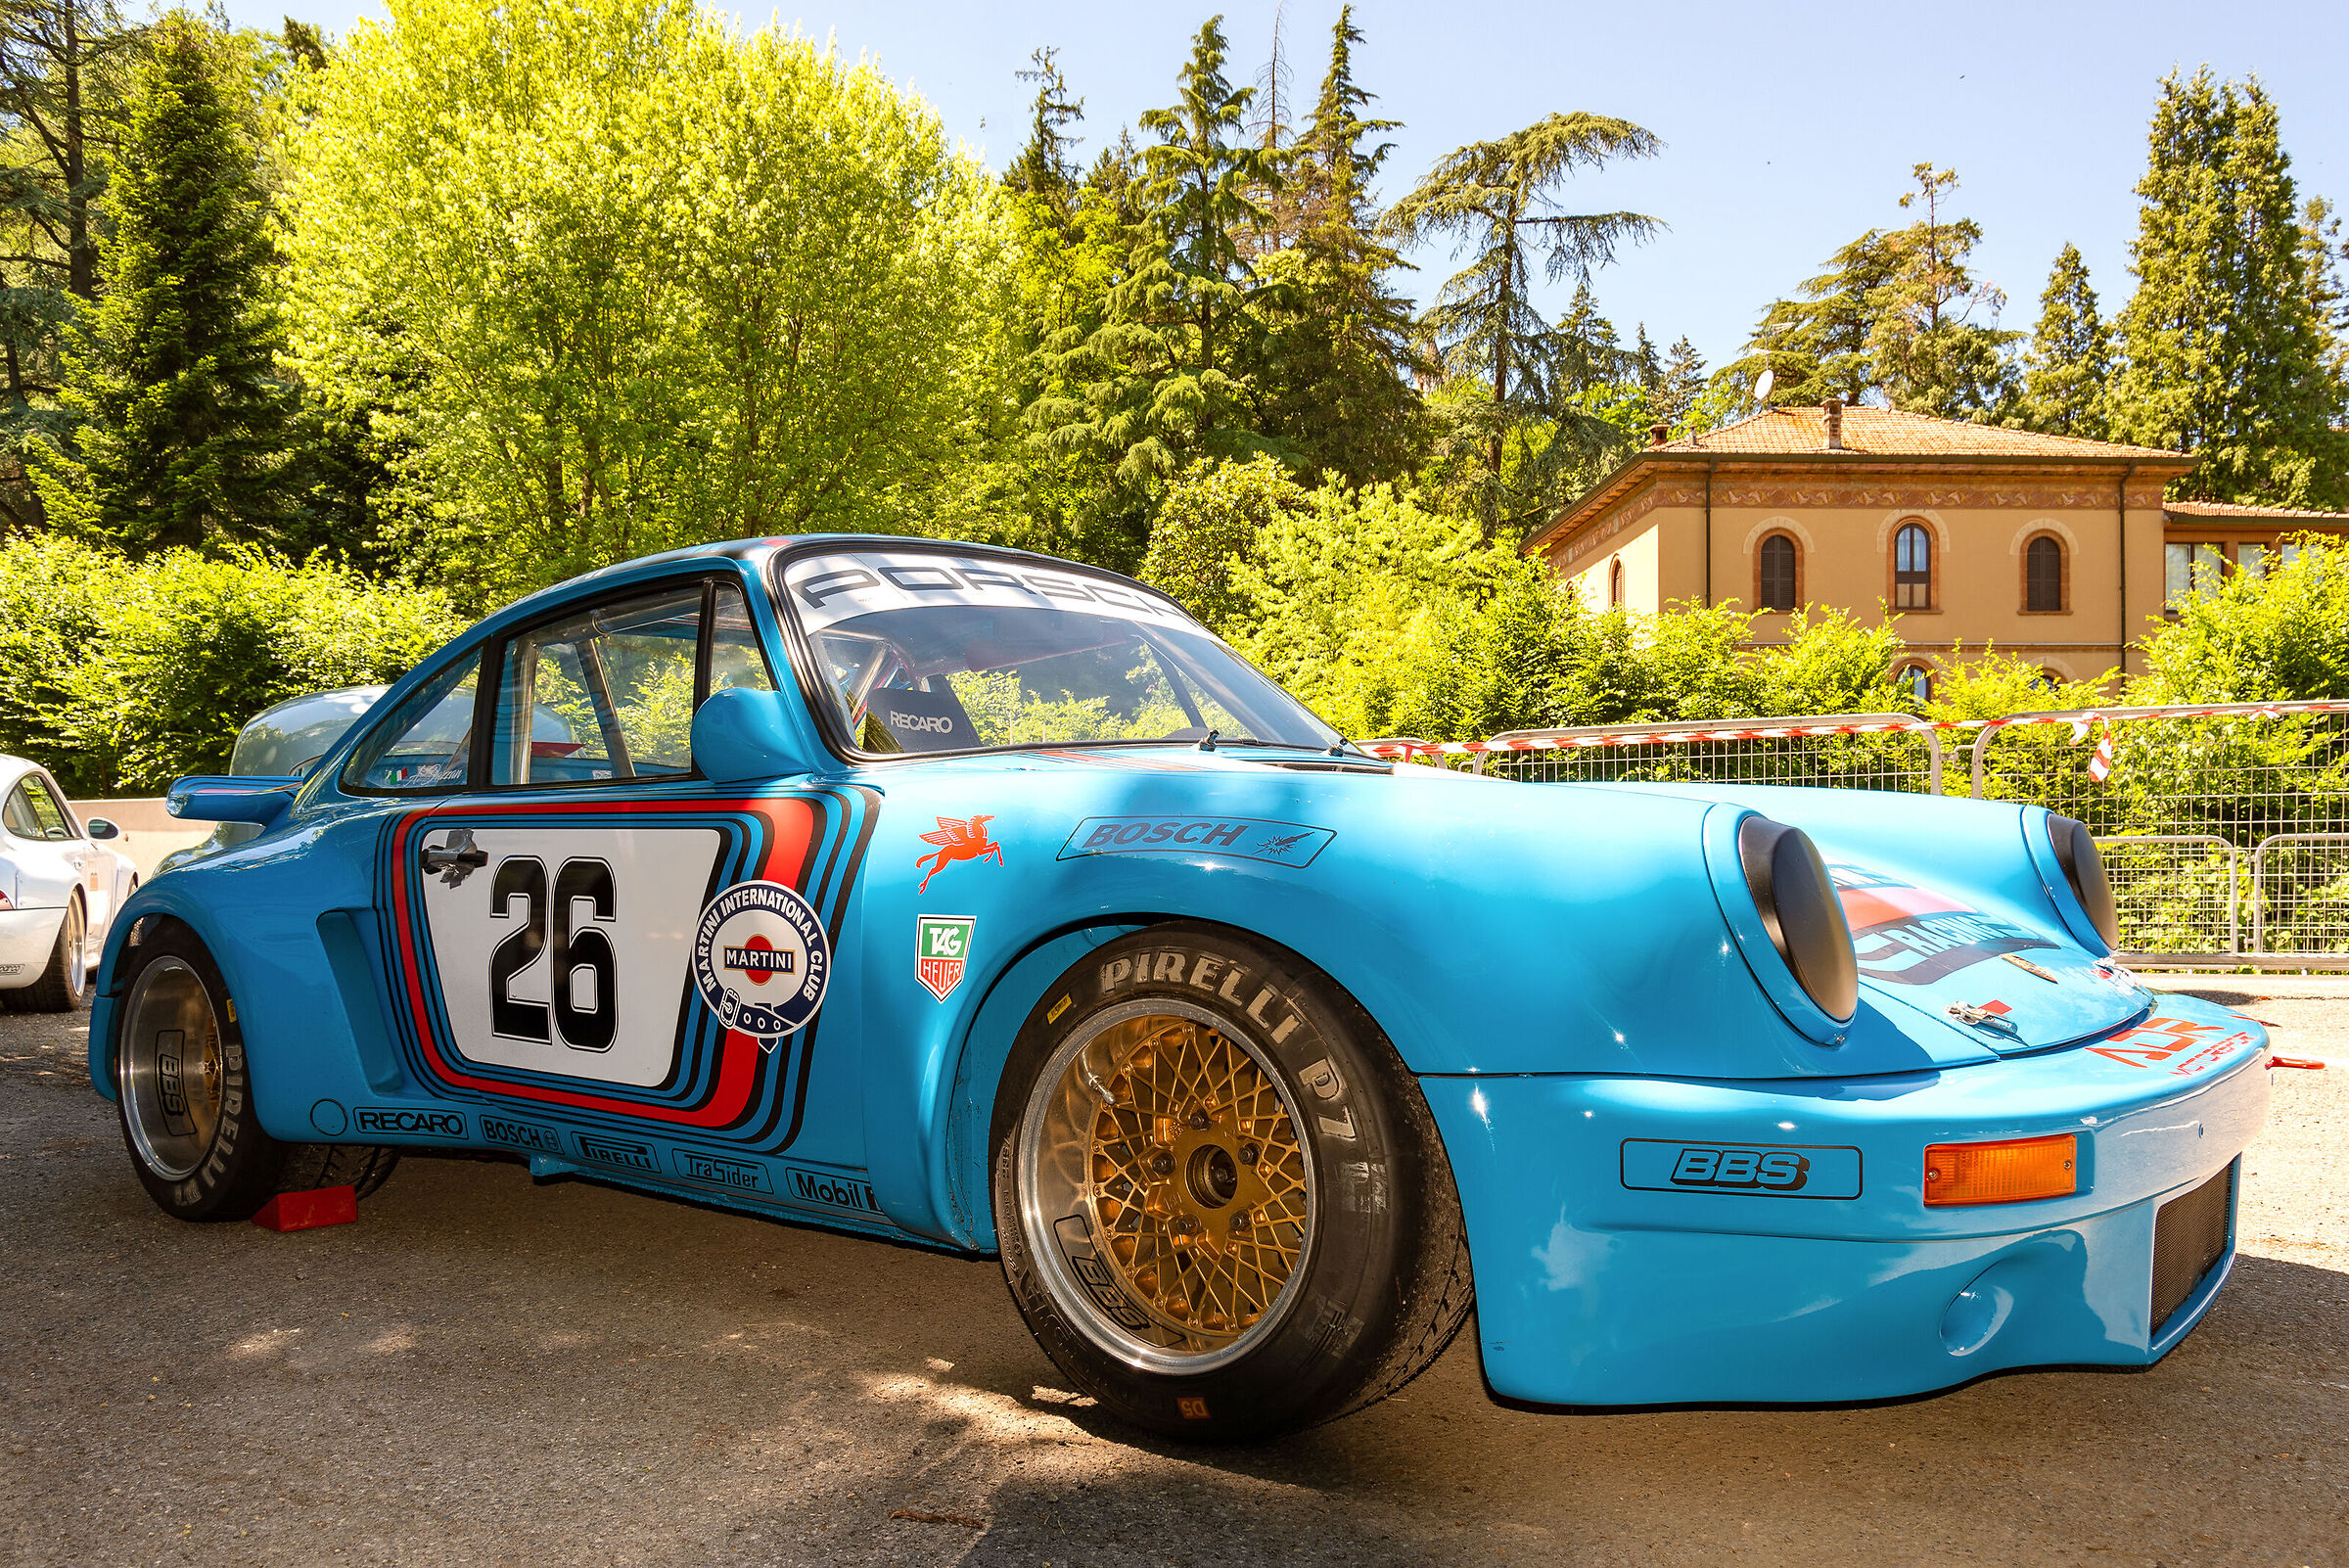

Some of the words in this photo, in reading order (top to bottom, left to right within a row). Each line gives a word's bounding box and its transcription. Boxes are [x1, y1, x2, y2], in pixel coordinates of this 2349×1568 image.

[790, 567, 1199, 628] PORSCH
[890, 710, 953, 735] RECARO
[1081, 822, 1250, 849] BOSCH
[489, 854, 618, 1053] 26
[697, 915, 722, 993] MARTINI
[719, 888, 818, 947] INTERNATIONAL
[803, 949, 823, 1001] CLUB
[929, 925, 963, 957] TAG
[1882, 916, 2011, 956] RACING
[725, 948, 793, 970] MARTINI
[922, 960, 963, 994] HEUER
[1100, 948, 1304, 1045] PIRELLI
[1298, 1057, 1358, 1142] P7
[158, 1053, 186, 1118] BBS
[200, 1043, 244, 1188] PIRELLI
[358, 1111, 464, 1135] RECARO
[483, 1119, 543, 1149] BOSCH
[578, 1135, 653, 1170] PIRELLI
[1669, 1148, 1811, 1191] BBS
[795, 1172, 864, 1209] Mobil
[1071, 1255, 1152, 1331] BBS
[1180, 1401, 1208, 1417] D5
